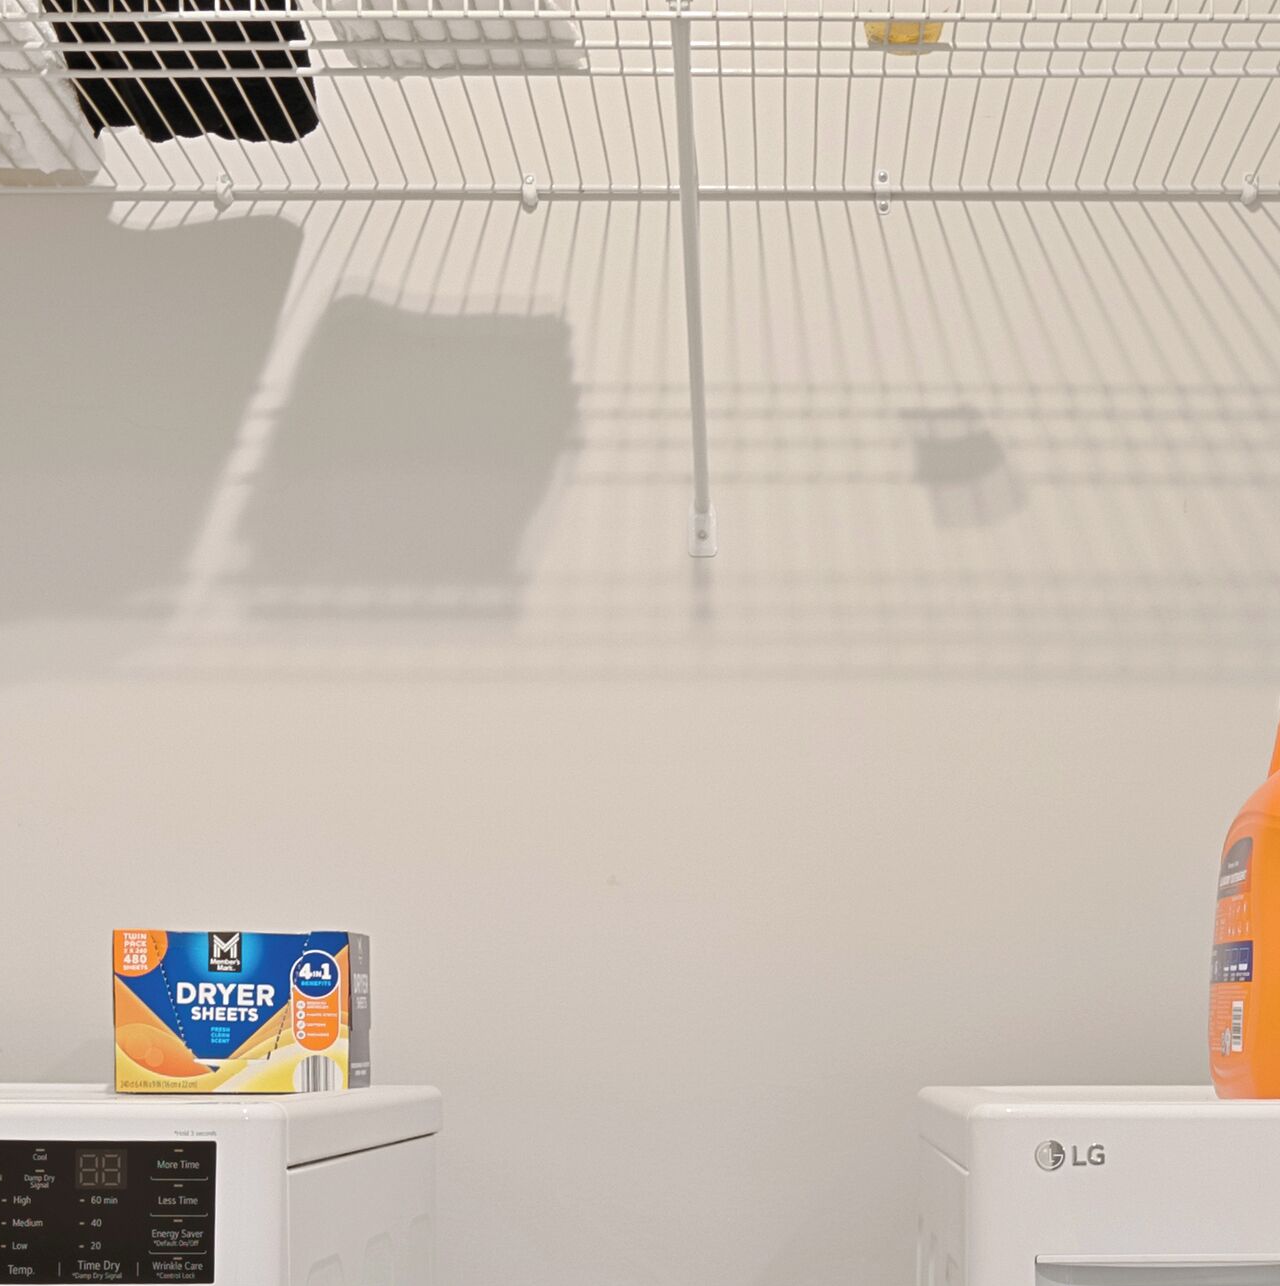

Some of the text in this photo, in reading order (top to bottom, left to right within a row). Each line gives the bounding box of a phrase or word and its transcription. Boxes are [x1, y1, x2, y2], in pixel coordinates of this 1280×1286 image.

[123, 954, 147, 964] 480
[176, 982, 275, 1006] DRYER
[191, 1006, 259, 1022] SHEETS
[32, 1153, 48, 1161] Cool
[1072, 1144, 1105, 1166] LG
[157, 1160, 200, 1169] More Time
[43, 1174, 55, 1183] Dry
[13, 1196, 31, 1206] High
[90, 1196, 118, 1205] 60 min
[158, 1196, 198, 1205] Less Time
[12, 1218, 43, 1227] Medium
[90, 1218, 102, 1227] 40
[151, 1229, 203, 1240] Energy Saver
[12, 1242, 28, 1250] Low
[90, 1241, 101, 1250] 20
[8, 1264, 35, 1277] Temp.
[77, 1260, 121, 1273] Time Dry
[152, 1261, 203, 1271] Wrinkle Care
